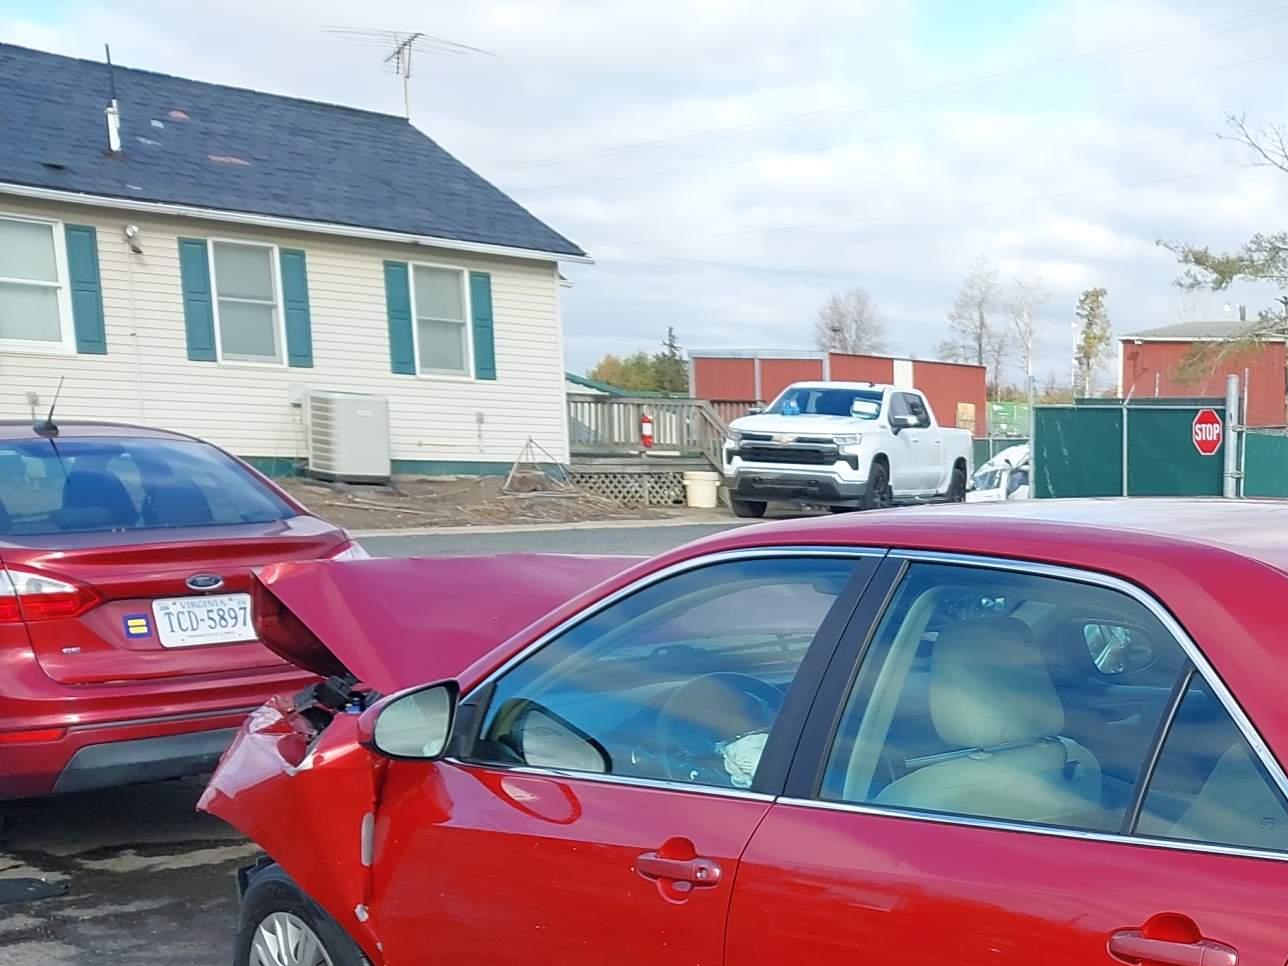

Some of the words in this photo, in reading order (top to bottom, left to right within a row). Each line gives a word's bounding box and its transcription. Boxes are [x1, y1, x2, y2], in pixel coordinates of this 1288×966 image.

[1195, 423, 1220, 441] STOP
[179, 599, 226, 609] VIRGINIA
[164, 606, 248, 633] TCD-5897
